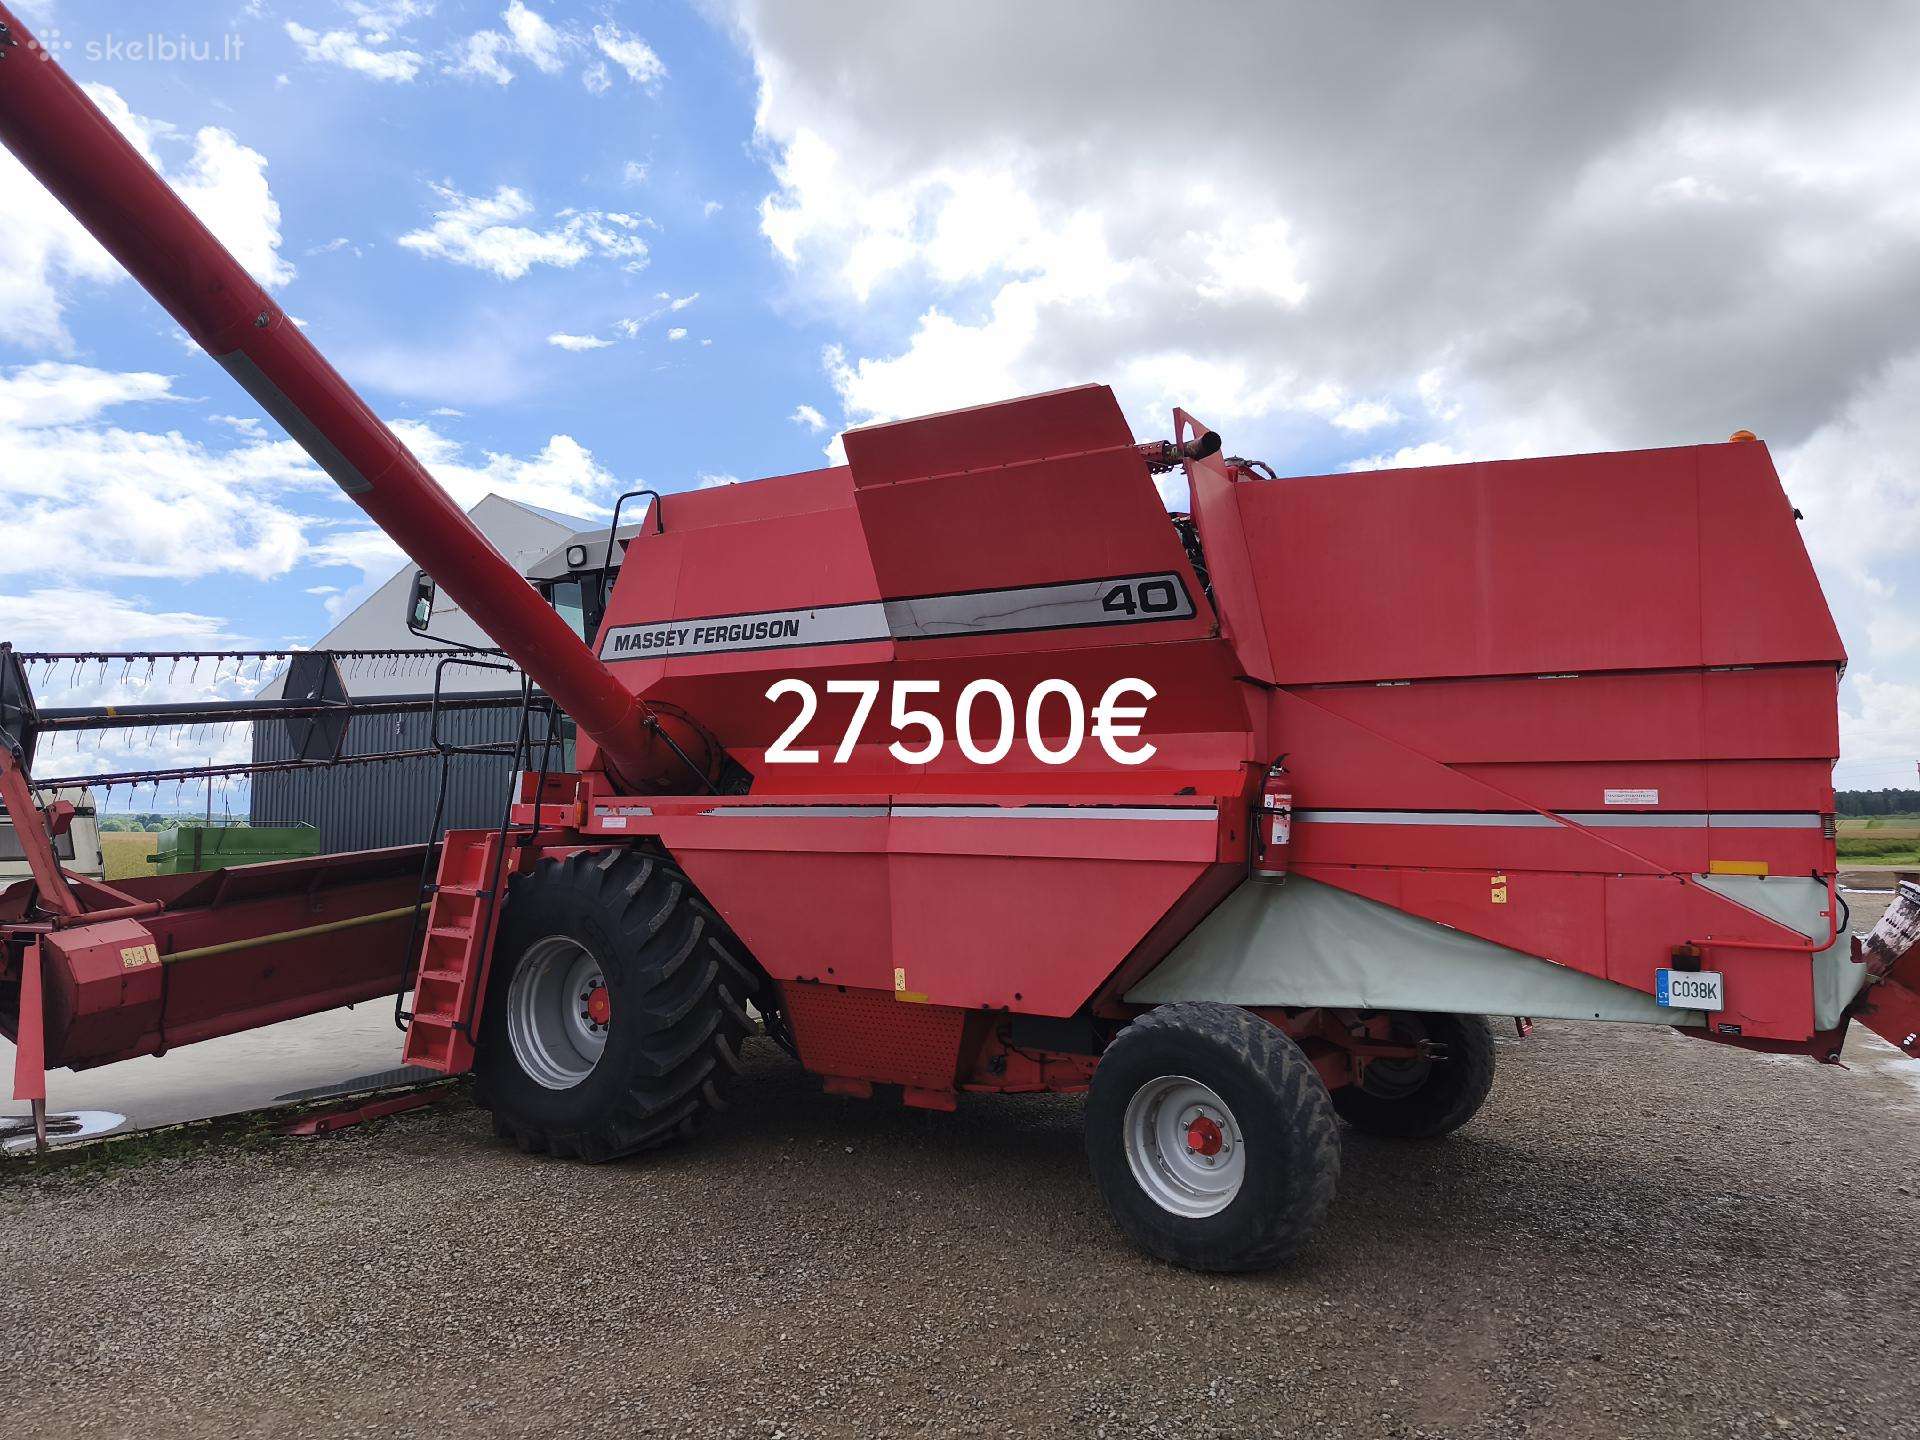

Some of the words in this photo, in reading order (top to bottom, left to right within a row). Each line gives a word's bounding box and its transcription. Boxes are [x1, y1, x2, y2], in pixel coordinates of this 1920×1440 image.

[1102, 580, 1178, 615] 40
[614, 628, 690, 652] MASSEY
[692, 619, 800, 645] FERGUSON
[1672, 980, 1718, 1000] C038K
